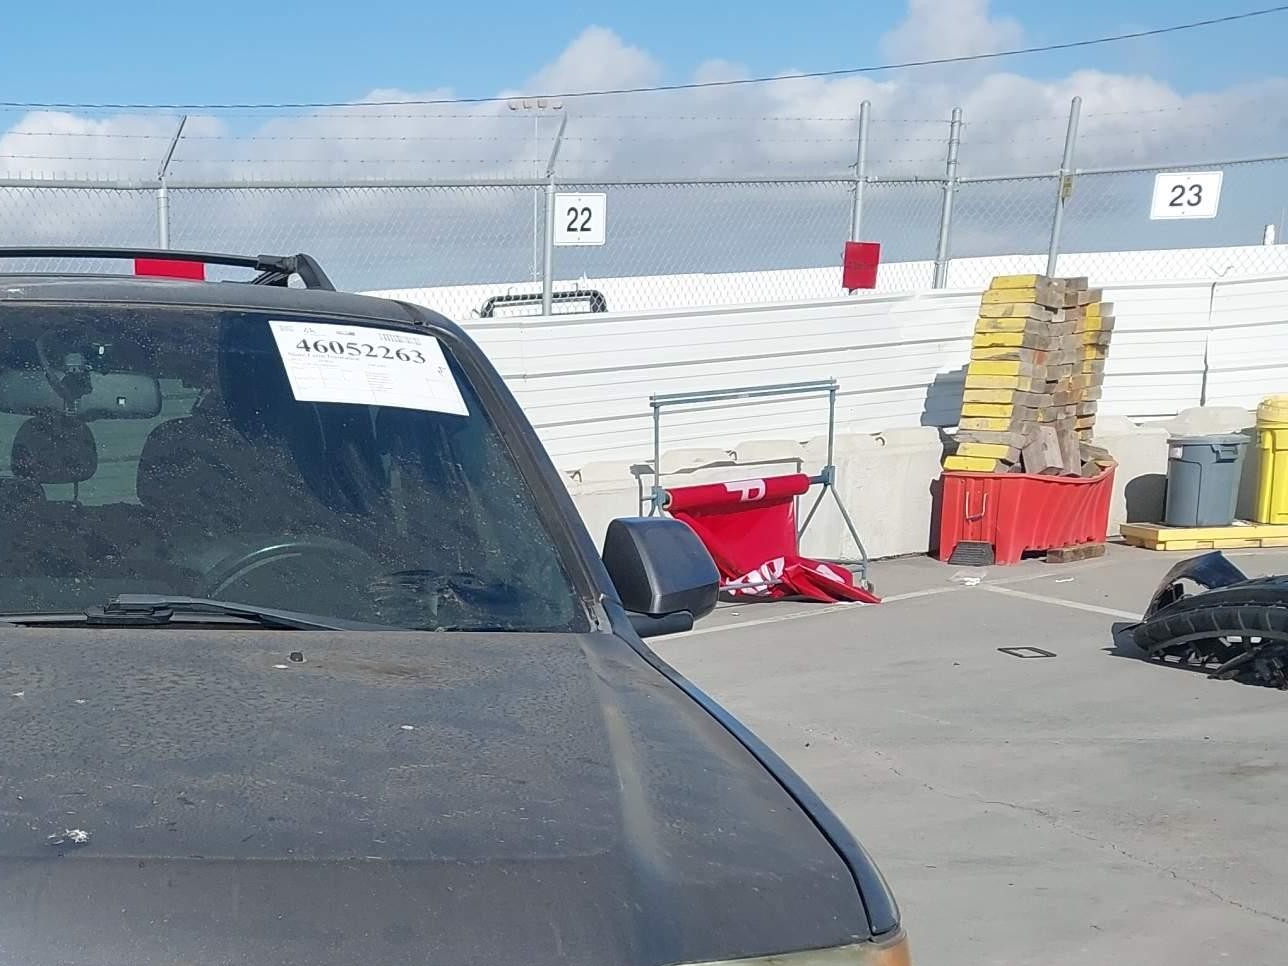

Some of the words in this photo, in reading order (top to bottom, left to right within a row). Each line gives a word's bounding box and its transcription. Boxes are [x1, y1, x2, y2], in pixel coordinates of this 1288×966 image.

[1168, 184, 1203, 207] 23
[566, 206, 592, 232] 22
[295, 337, 428, 365] 46052263
